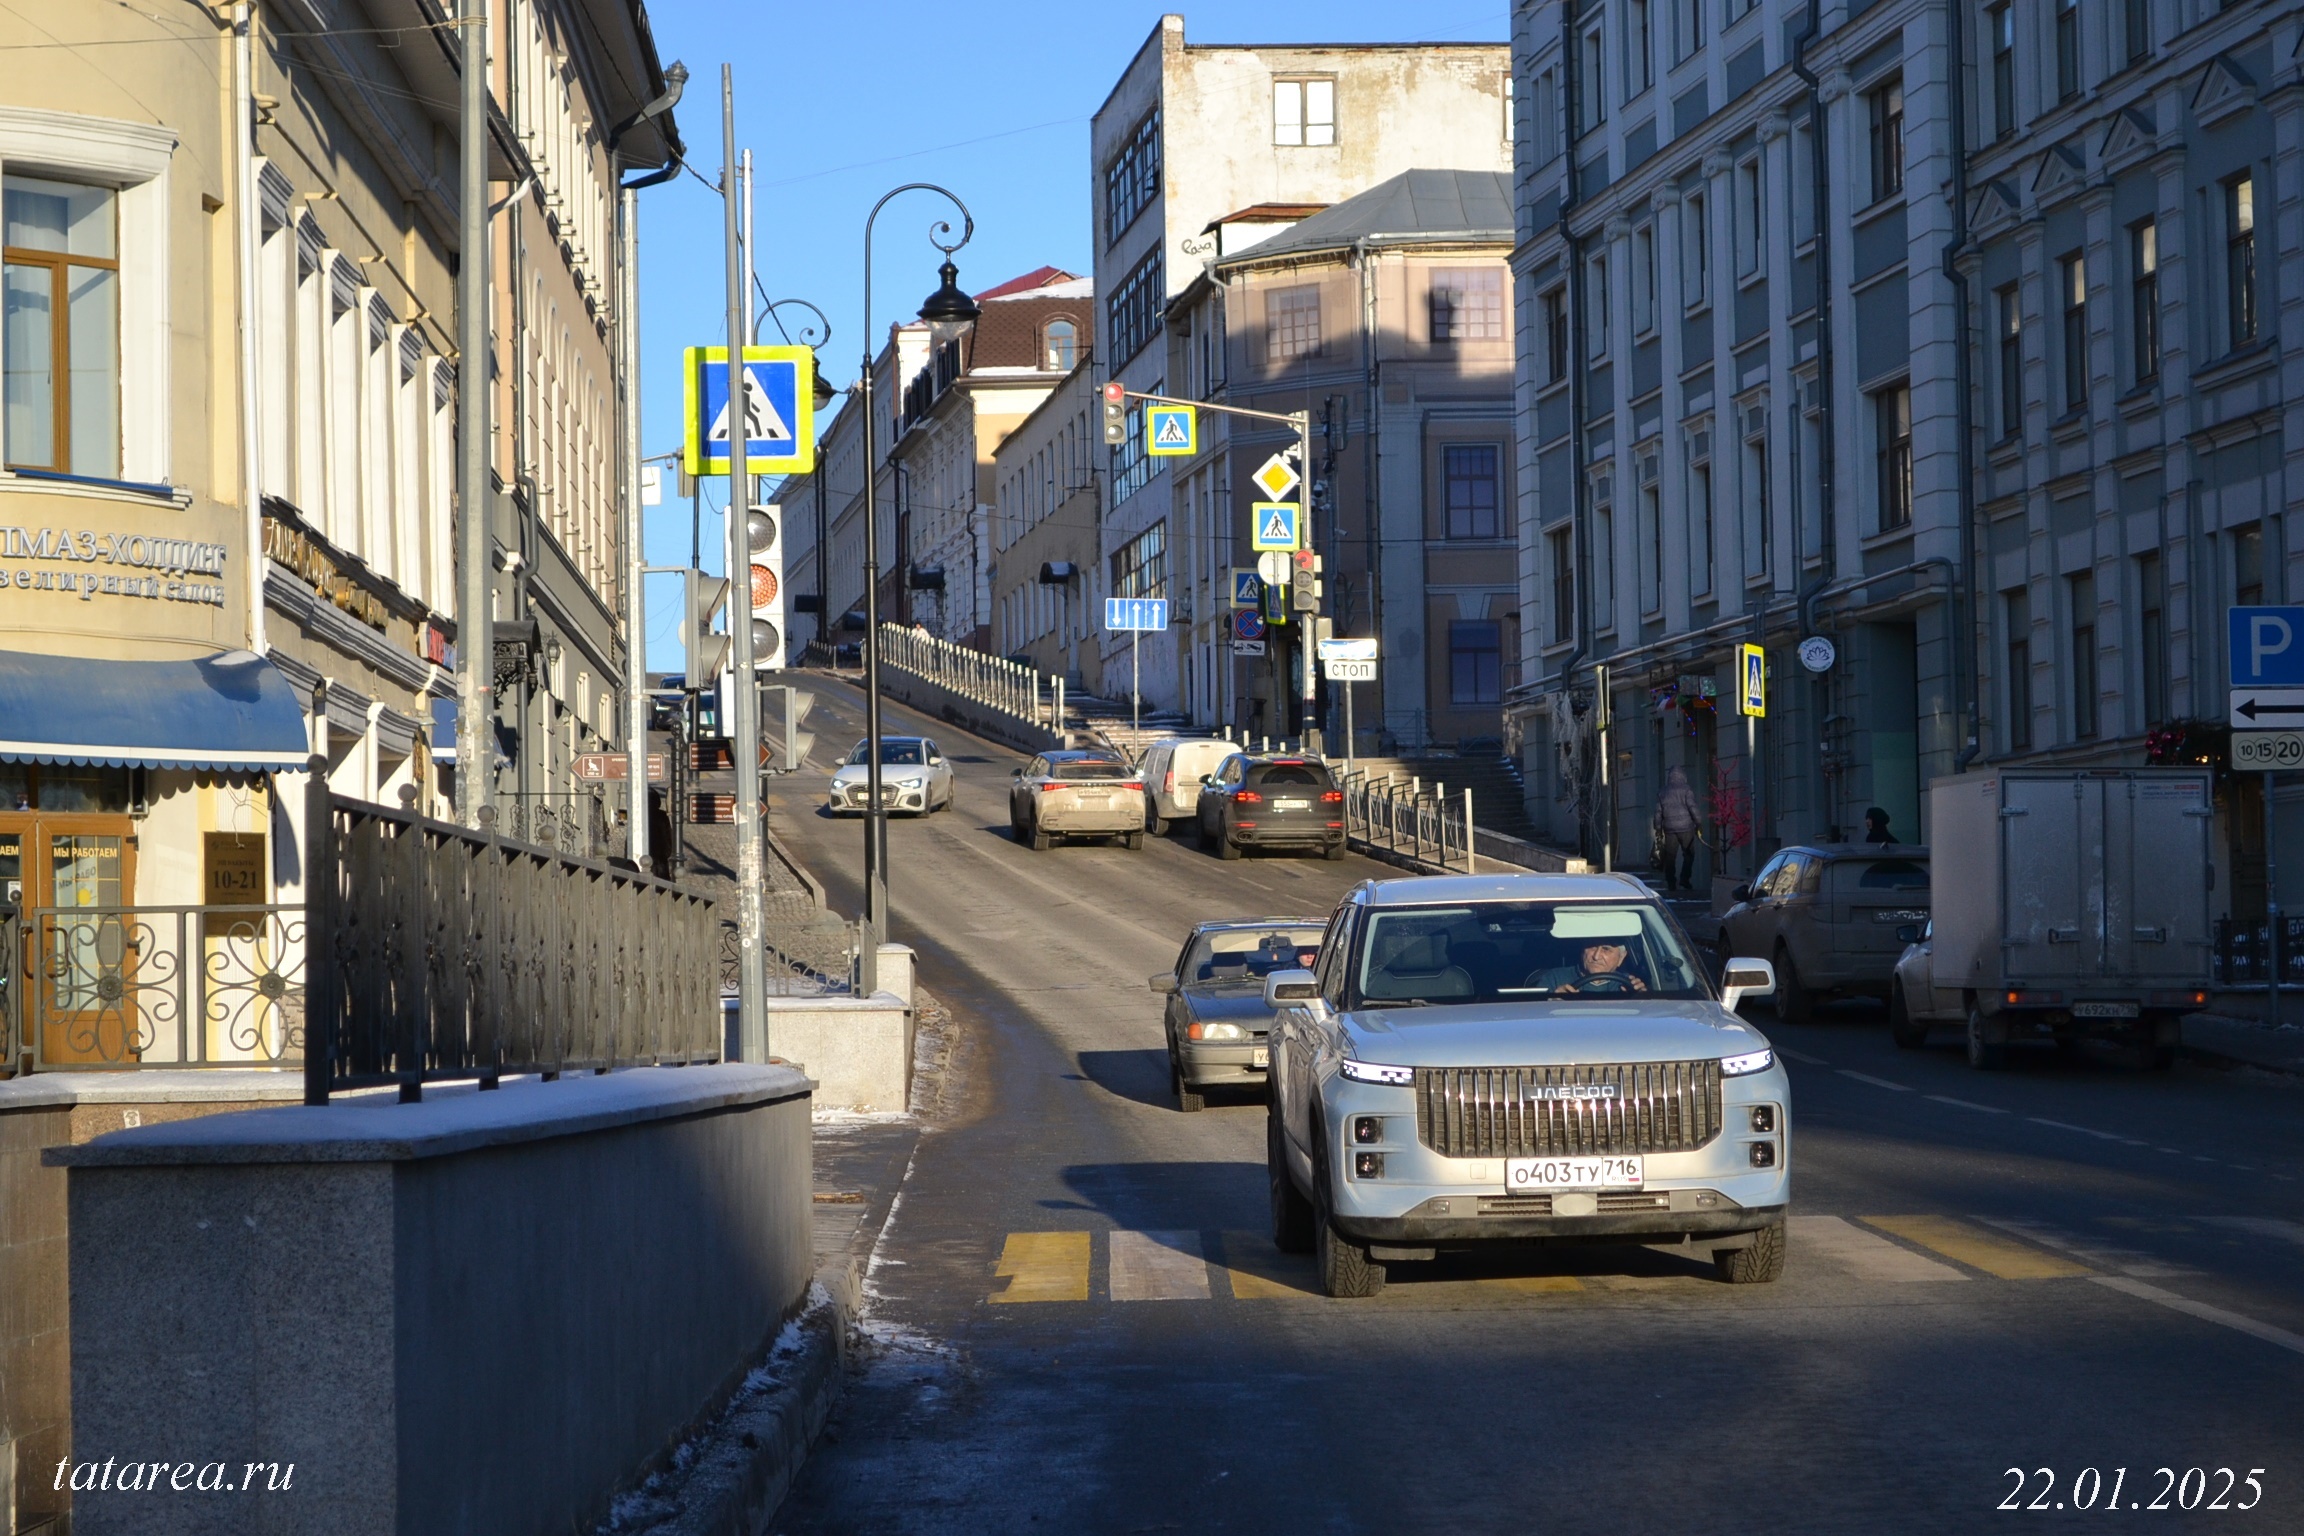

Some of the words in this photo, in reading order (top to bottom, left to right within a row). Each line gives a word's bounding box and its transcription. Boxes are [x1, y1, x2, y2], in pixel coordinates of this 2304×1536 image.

[166, 580, 225, 605] салон
[2251, 616, 2292, 677] P
[1332, 664, 1369, 677] СТОП
[2241, 745, 2253, 756] 10
[2257, 743, 2272, 757] 15
[2278, 741, 2300, 758] 20
[53, 847, 69, 858] МЫ
[71, 847, 117, 858] РАБОТАЕМ
[213, 870, 257, 889] 10-21
[1604, 1159, 1636, 1176] 716
